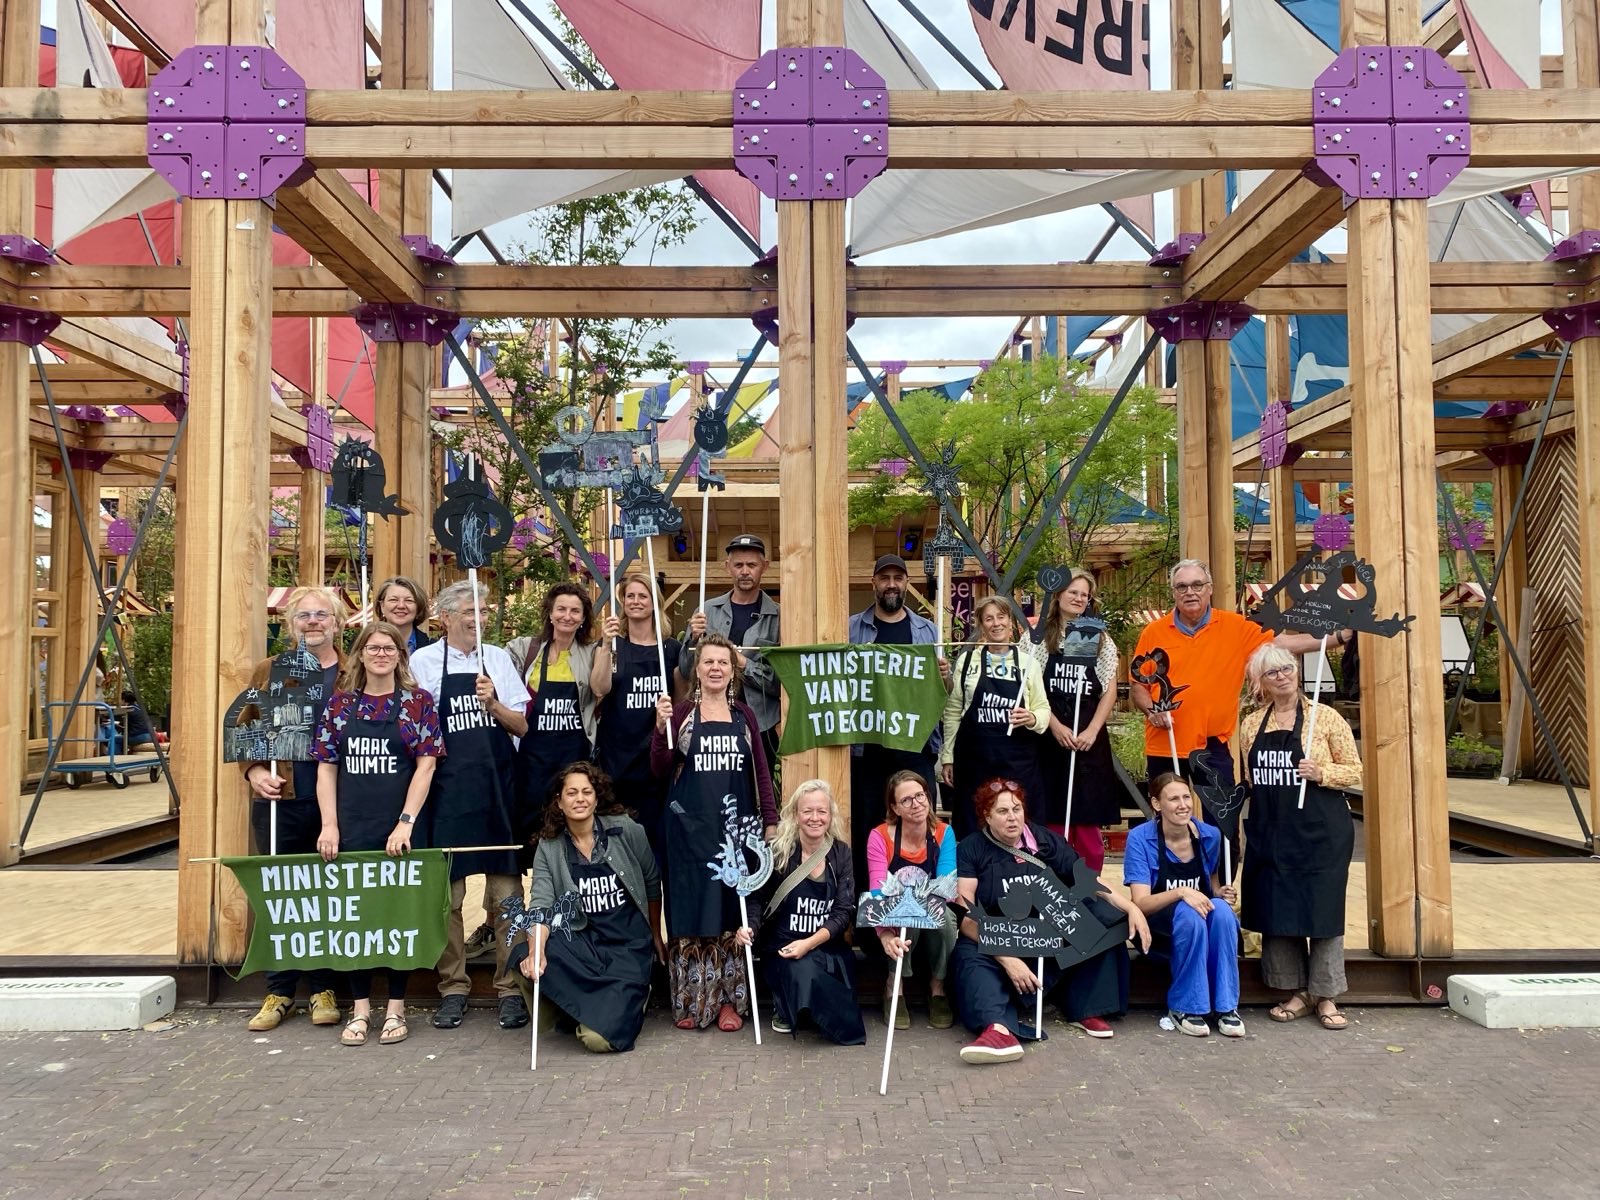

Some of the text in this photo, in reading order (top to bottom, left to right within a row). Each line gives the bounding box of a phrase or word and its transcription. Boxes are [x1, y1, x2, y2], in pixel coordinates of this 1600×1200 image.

[1284, 613, 1340, 630] TOEKOMST
[800, 650, 926, 680] MINISTERIE
[632, 675, 664, 692] MAA
[450, 694, 482, 714] MAA
[544, 698, 577, 715] MAAK
[537, 714, 583, 731] RUIMTE
[808, 709, 920, 738] TOEKOMST
[347, 736, 391, 755] MAAK
[700, 735, 740, 753] MAAK
[345, 755, 398, 774] RUIMTE
[694, 753, 745, 772] RUIMTE
[1257, 750, 1294, 768] MAAK
[1252, 768, 1302, 786] RUIMTE
[260, 860, 423, 892] MINISTERIE
[578, 873, 618, 895] MAAK
[581, 888, 626, 913] UIMTE
[1035, 877, 1068, 908] MAAK
[265, 895, 361, 925] VAN DE
[269, 928, 419, 961] TOEKOMST
[1012, 935, 1063, 949] TOEKOMST
